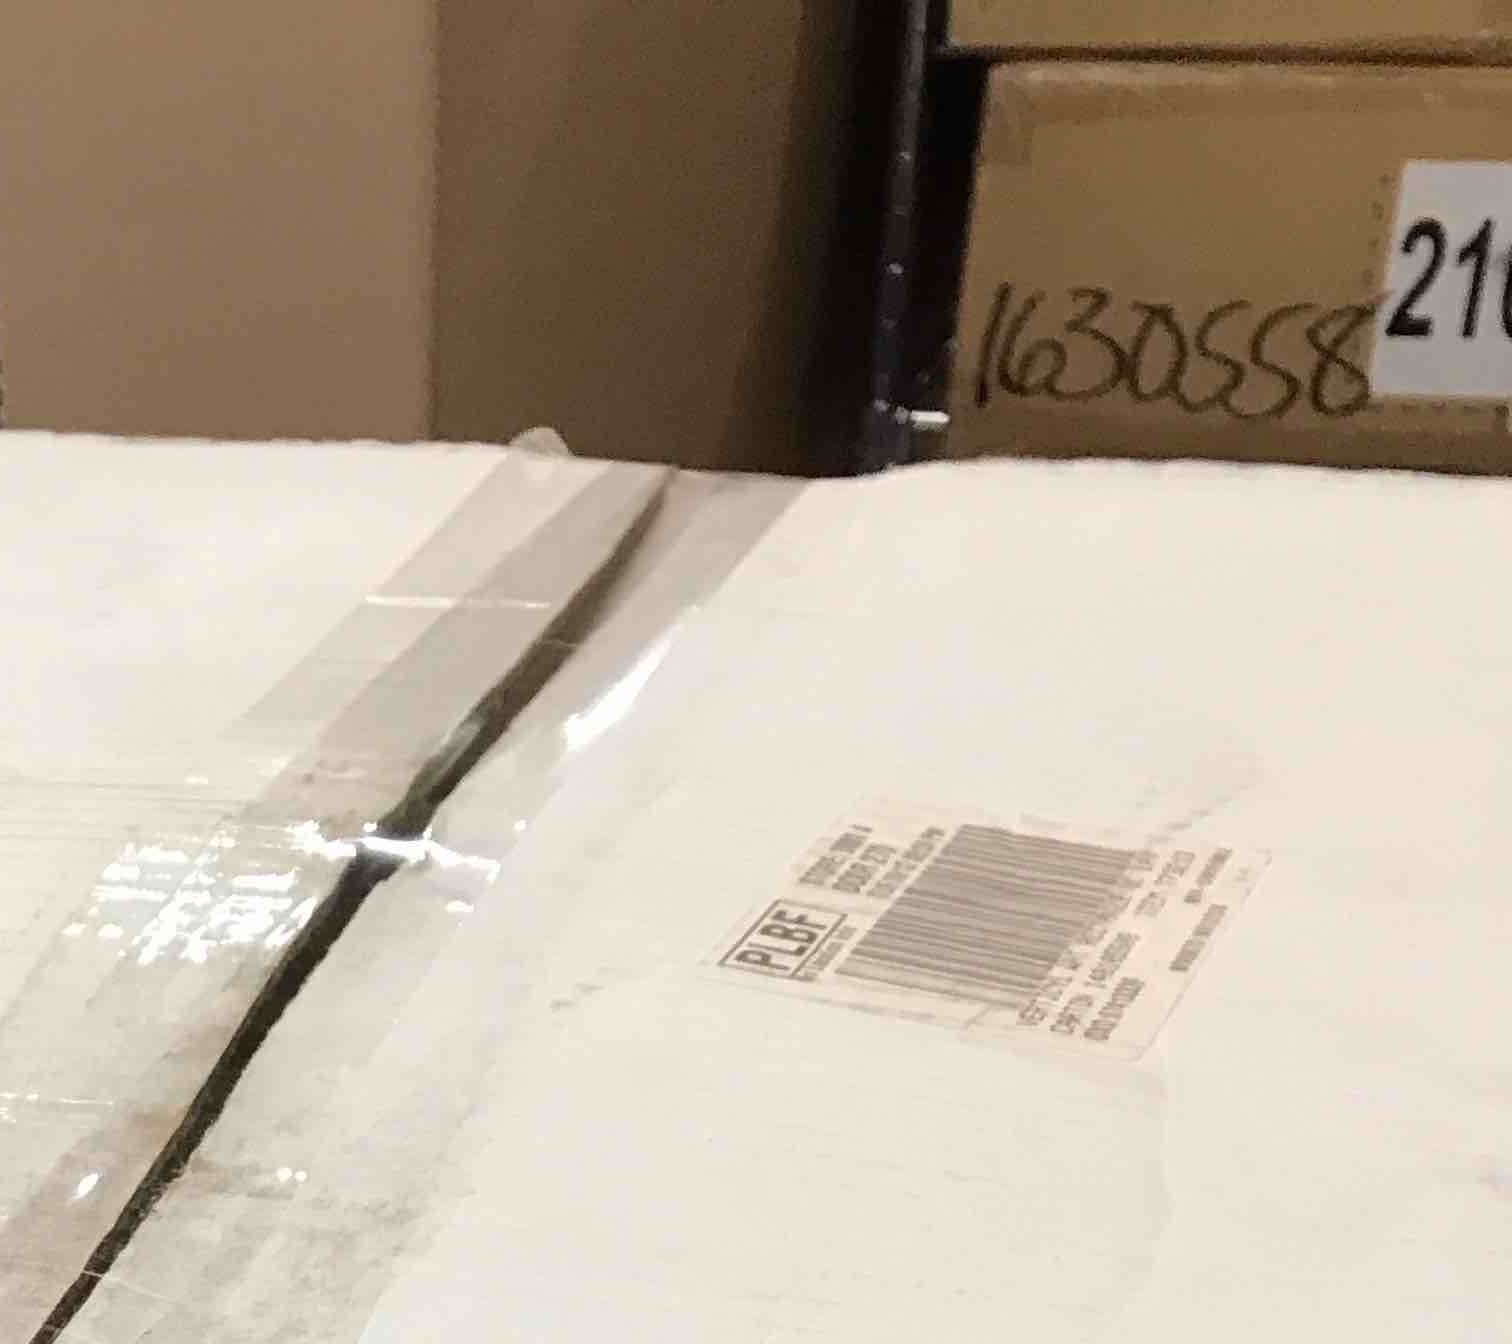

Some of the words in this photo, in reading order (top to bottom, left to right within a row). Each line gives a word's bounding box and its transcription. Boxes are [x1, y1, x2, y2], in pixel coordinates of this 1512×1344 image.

[1385, 214, 1512, 340] 21
[975, 281, 1390, 419] 1630558
[734, 909, 828, 970] PLBF
